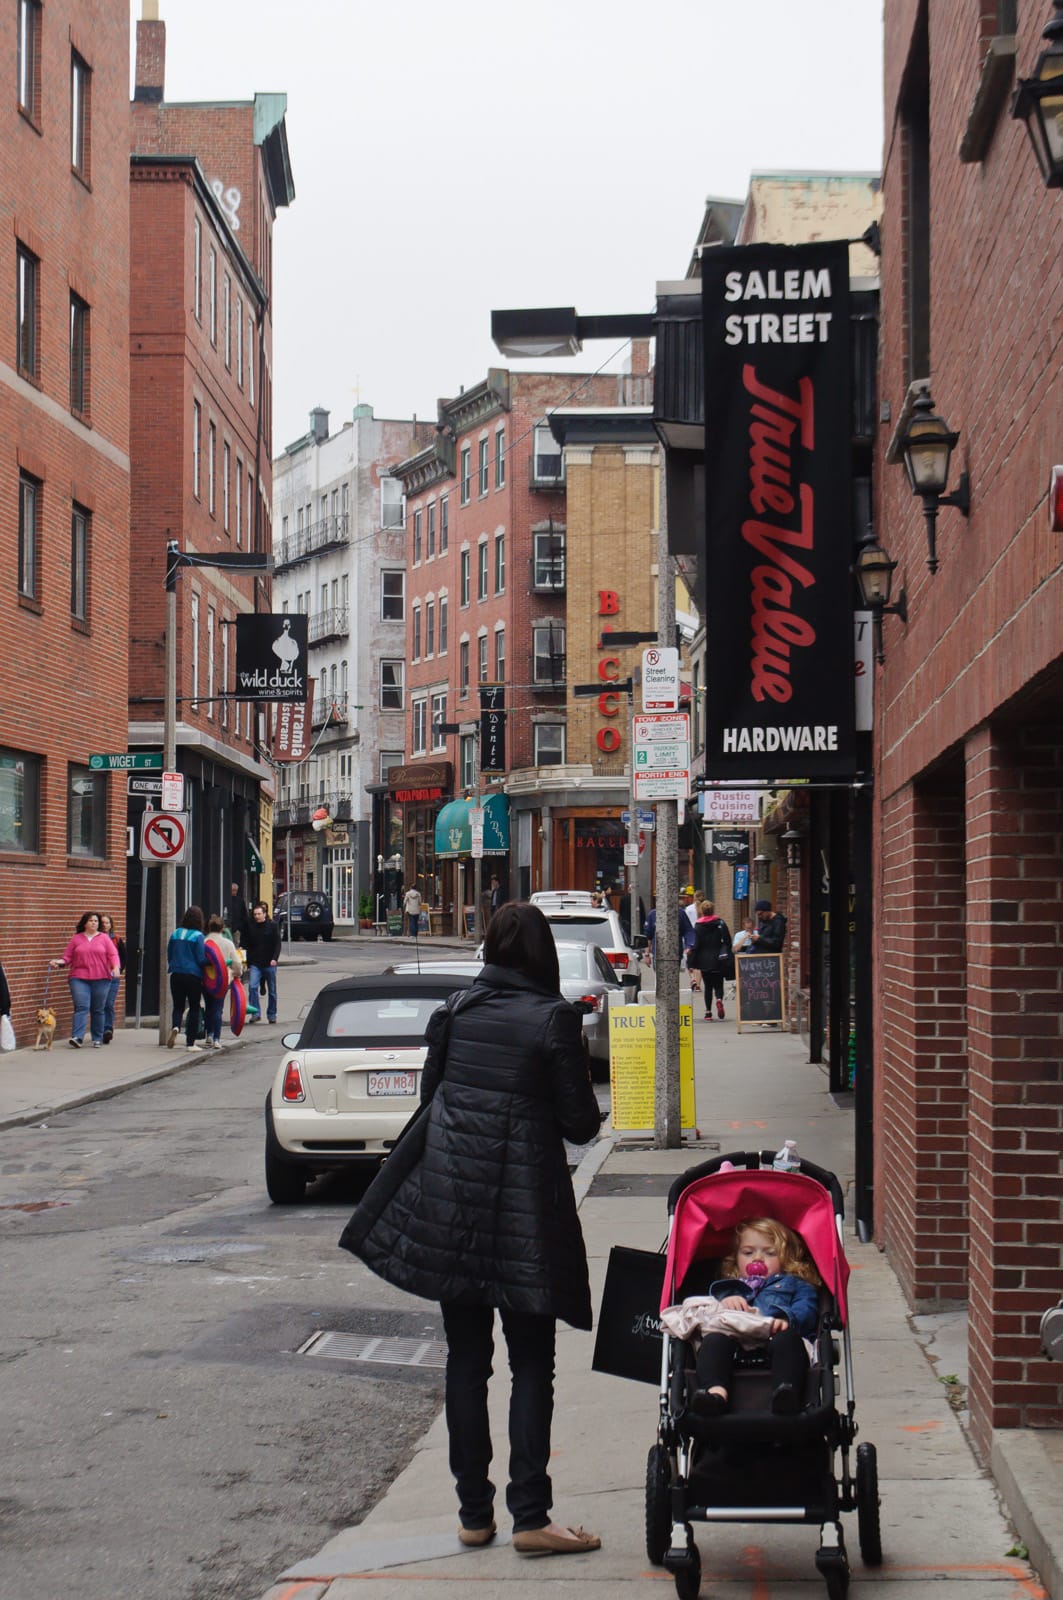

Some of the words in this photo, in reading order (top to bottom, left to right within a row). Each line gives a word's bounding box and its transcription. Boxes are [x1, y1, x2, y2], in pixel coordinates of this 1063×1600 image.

[724, 268, 833, 302] SALEM
[724, 313, 833, 345] STREET
[742, 364, 815, 515] True
[742, 482, 817, 703] Value
[240, 668, 267, 688] wild
[270, 668, 302, 688] duck
[646, 676, 676, 684] Cleaning
[280, 702, 292, 751] istorante
[722, 726, 839, 753] HARDWARE
[109, 756, 136, 767] WIGET
[639, 752, 645, 760] 2
[396, 790, 410, 802] PIZZA
[412, 789, 429, 801] PASTA
[713, 792, 751, 801] Rustic
[710, 802, 754, 810] Cuisine
[722, 812, 753, 820] Pizza
[612, 1016, 646, 1028] TRUE
[370, 1077, 390, 1089] 96V
[394, 1076, 414, 1088] M84
